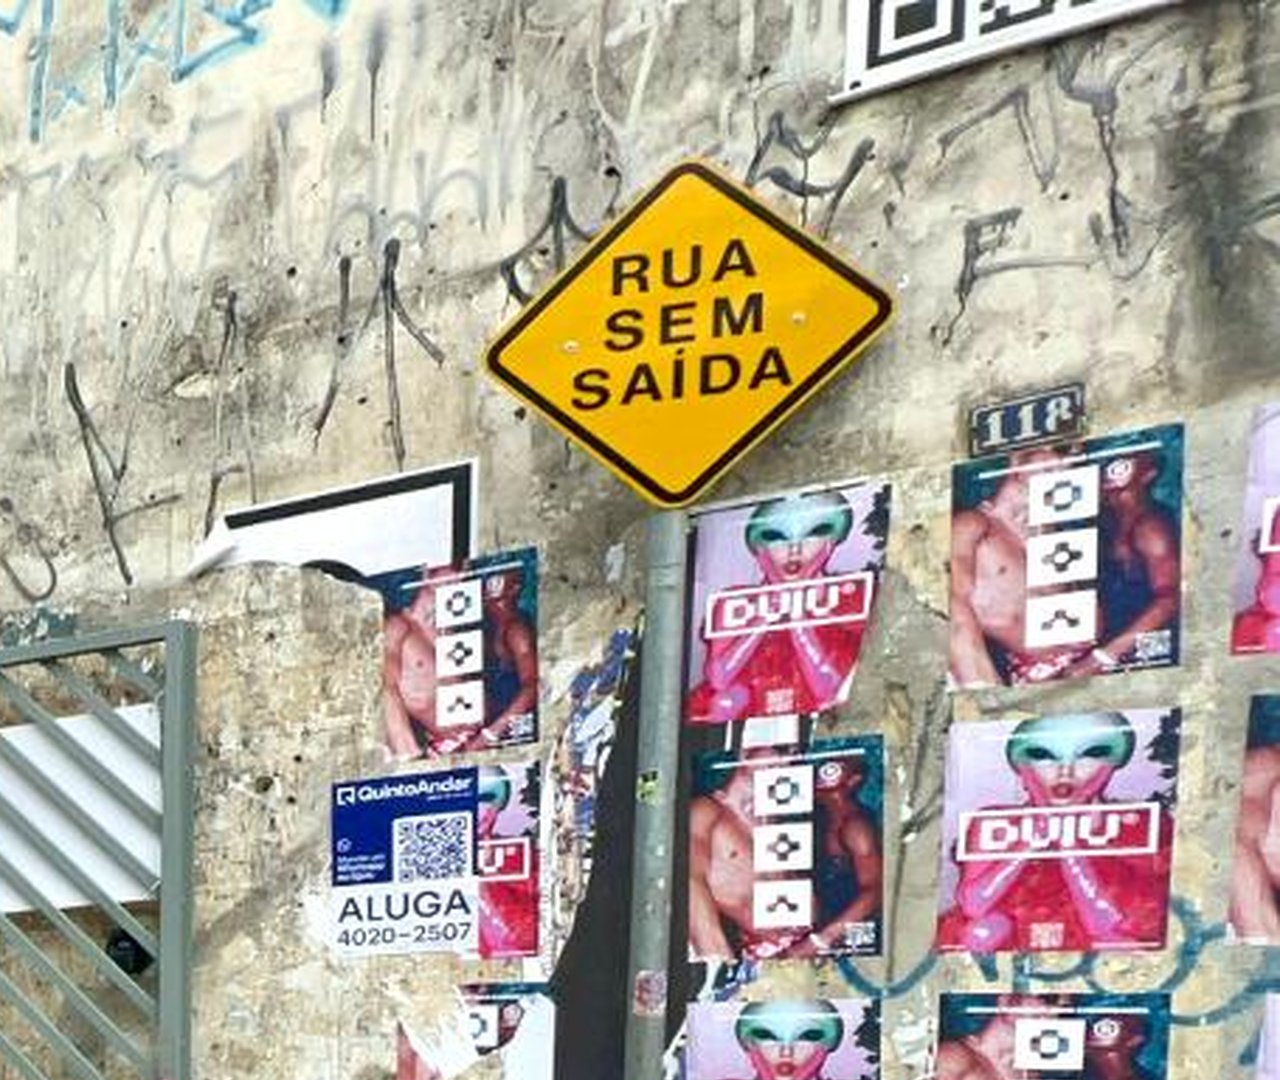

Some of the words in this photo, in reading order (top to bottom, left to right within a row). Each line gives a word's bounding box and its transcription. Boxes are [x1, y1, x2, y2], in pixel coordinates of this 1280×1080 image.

[611, 238, 757, 297] RUA
[604, 292, 764, 353] SEM
[571, 346, 793, 412] SAÍDA
[981, 395, 1074, 447] 118
[357, 775, 474, 802] QuintoAndar
[337, 888, 472, 923] ALUGA
[337, 922, 472, 947] 4020-2507
